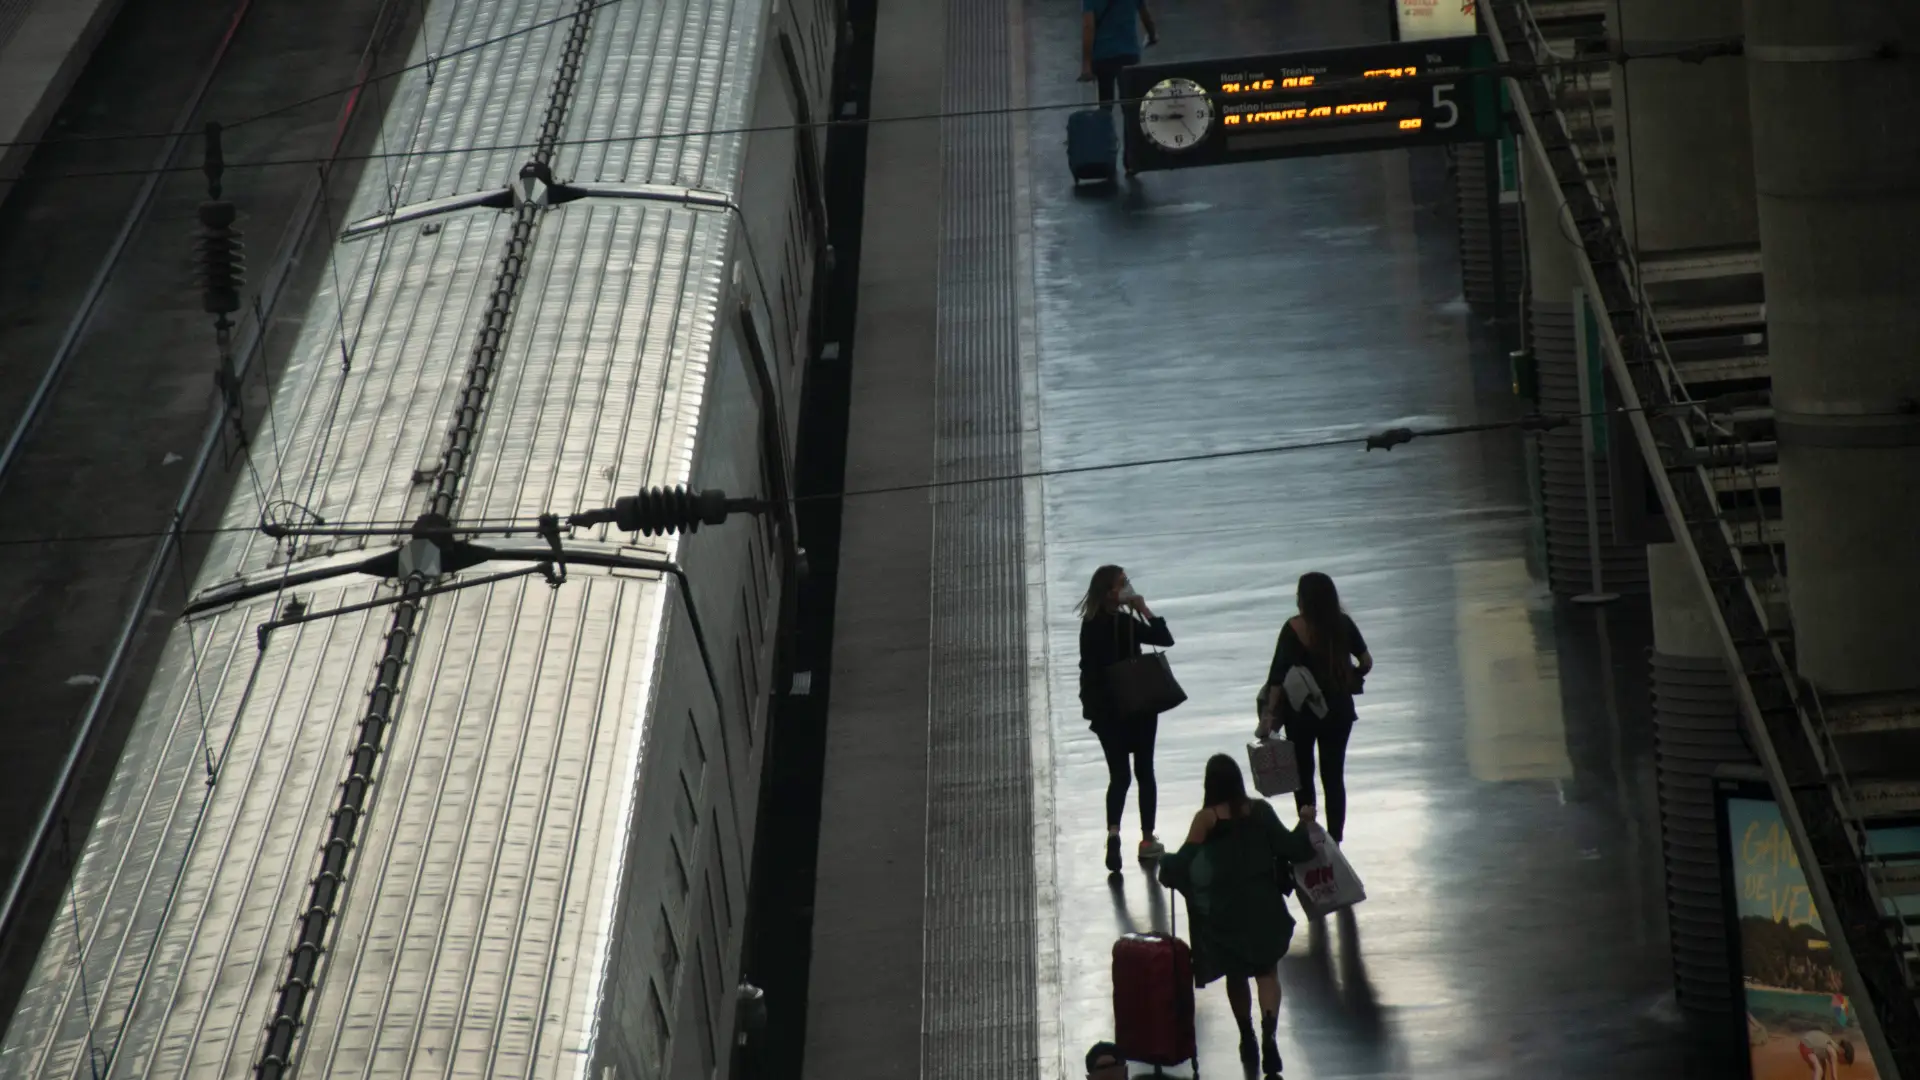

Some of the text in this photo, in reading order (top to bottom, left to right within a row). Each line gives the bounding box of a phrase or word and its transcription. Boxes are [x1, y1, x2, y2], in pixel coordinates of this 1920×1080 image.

[1220, 72, 1243, 82] Hora
[1280, 67, 1302, 77] Tren
[1222, 102, 1259, 114] Destino
[1432, 83, 1459, 129] 5
[1744, 873, 1769, 901] DE
